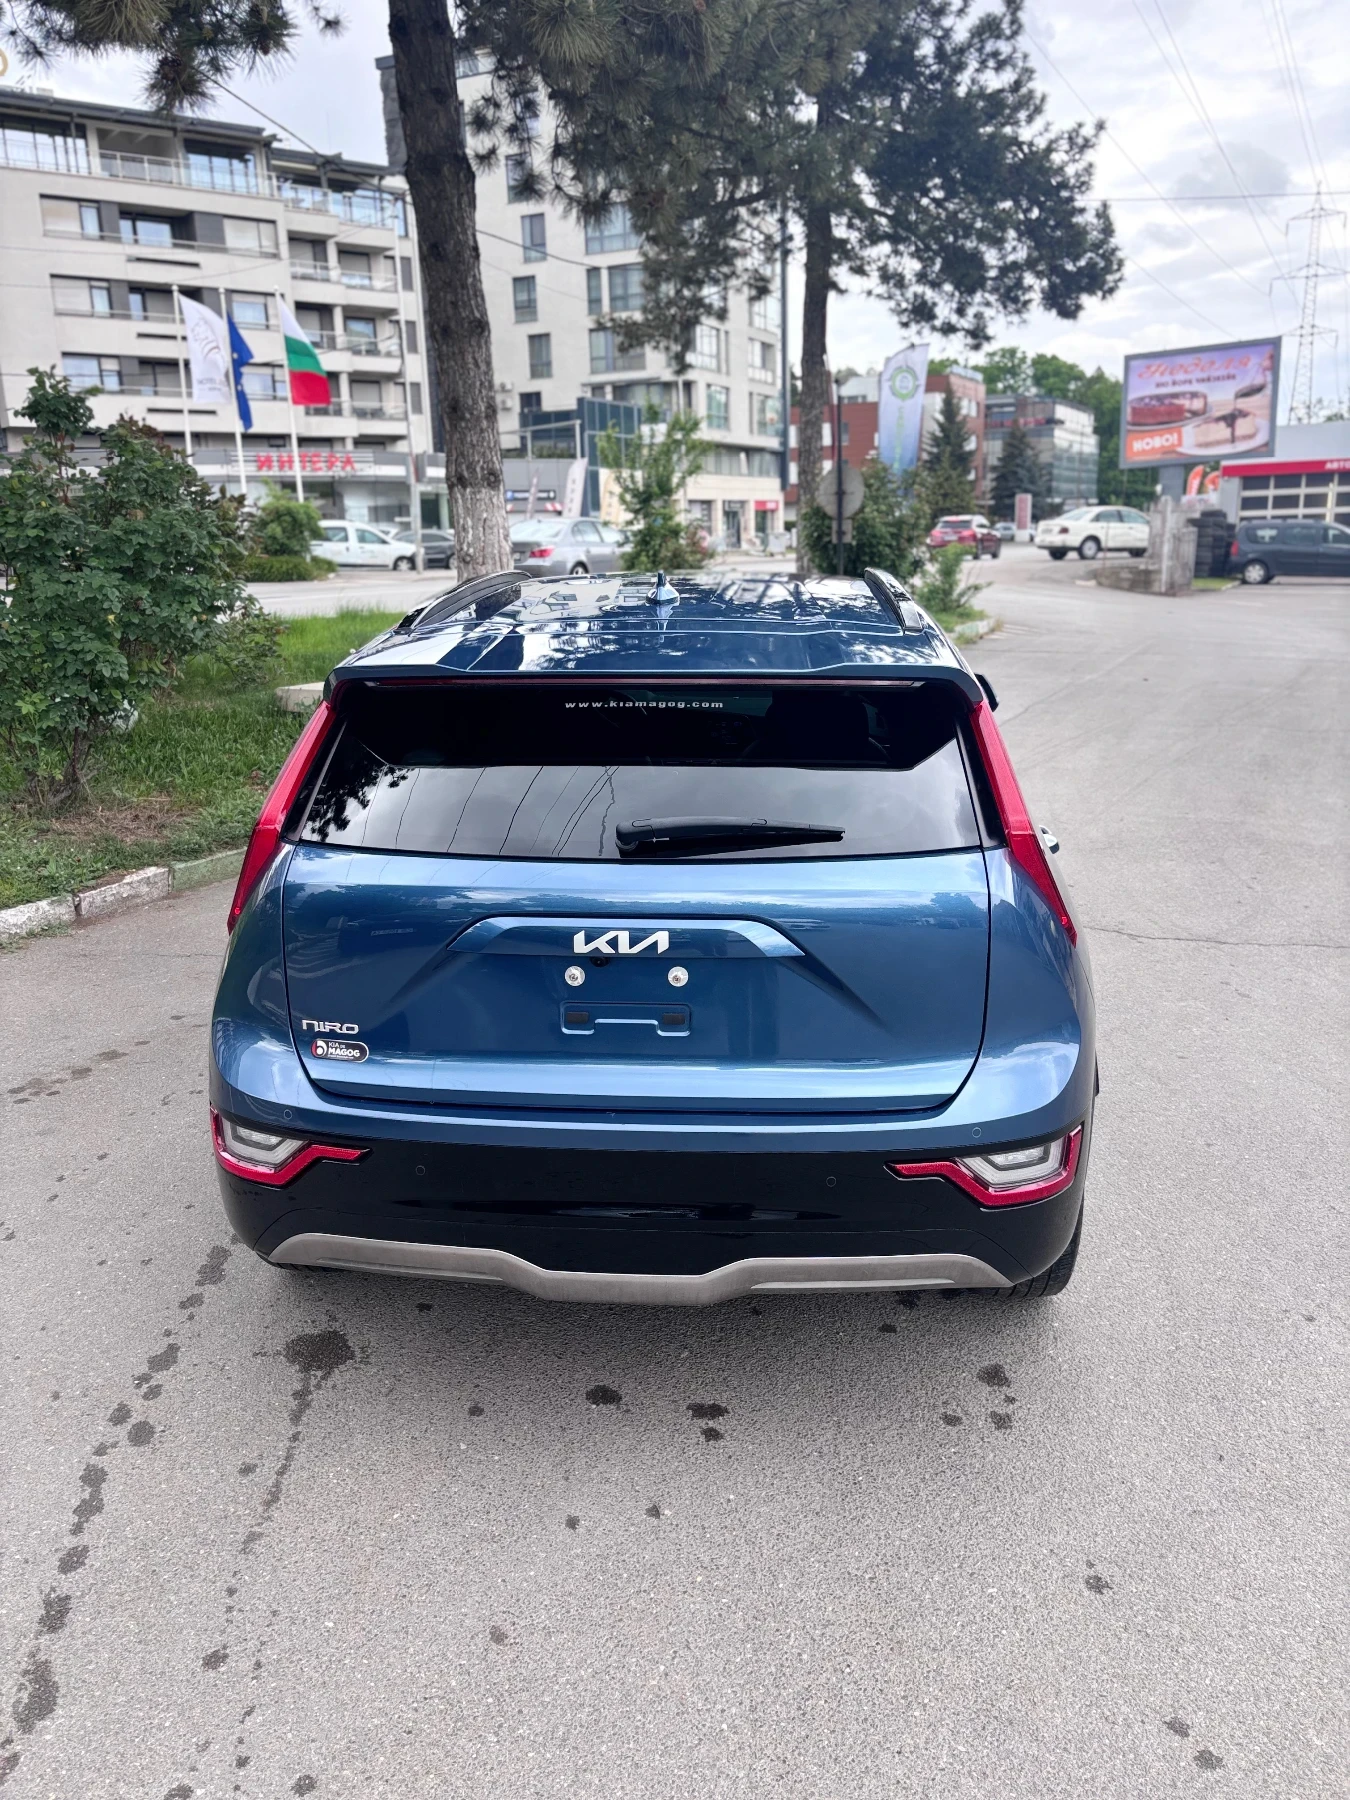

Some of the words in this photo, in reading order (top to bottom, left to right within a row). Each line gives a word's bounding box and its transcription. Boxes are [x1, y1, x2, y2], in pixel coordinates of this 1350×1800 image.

[1132, 432, 1179, 453] НОВО!
[564, 699, 724, 710] www.kiamagog.com
[573, 929, 670, 955] KIA
[302, 1019, 359, 1034] NIRO
[328, 1047, 360, 1057] MAGOG
